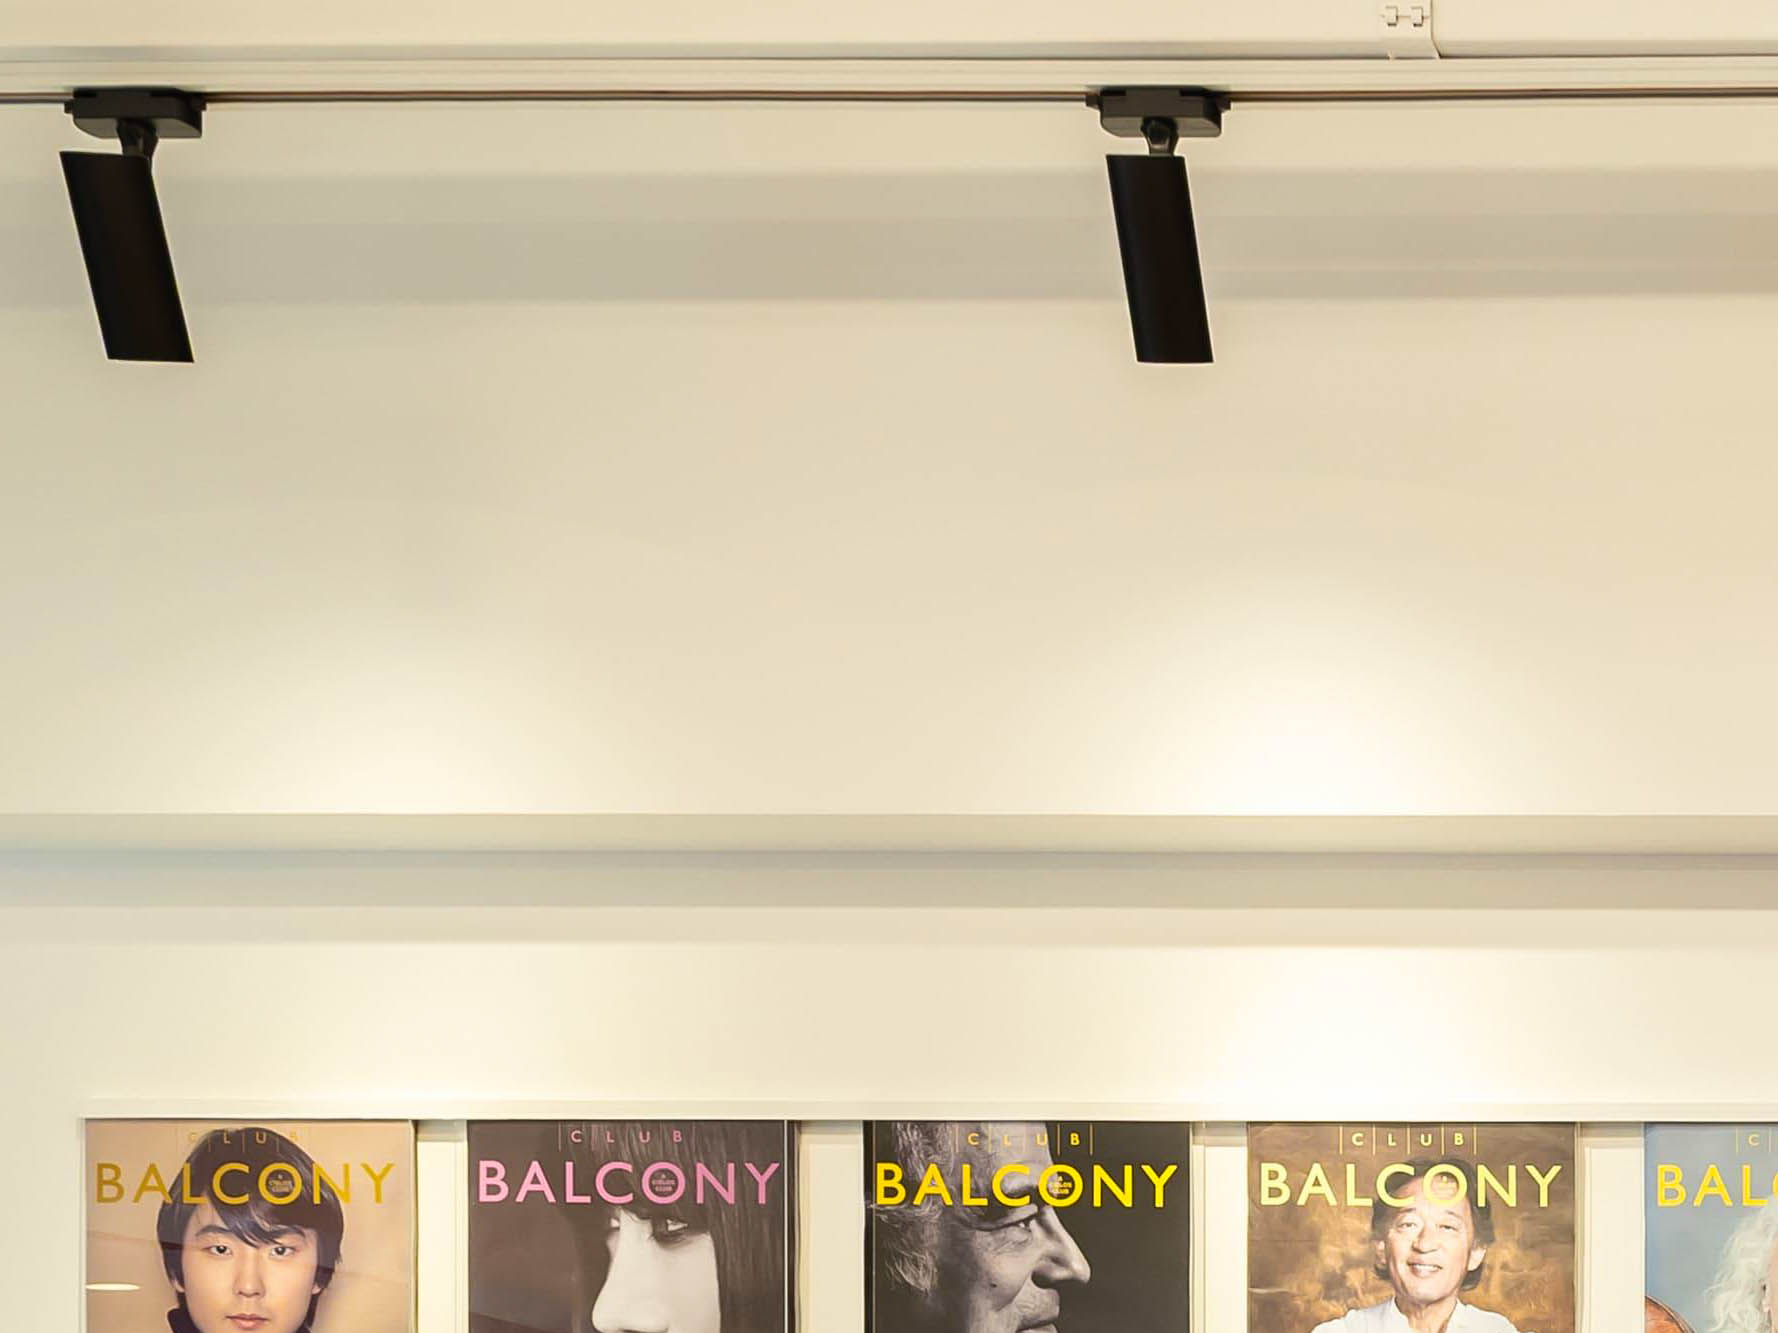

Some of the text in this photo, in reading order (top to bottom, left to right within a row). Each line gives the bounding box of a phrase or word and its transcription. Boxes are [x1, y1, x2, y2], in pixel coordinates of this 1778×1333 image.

[571, 1130, 683, 1143] CLUB
[968, 1133, 1080, 1146] CLUB
[1352, 1133, 1465, 1146] CLUB
[96, 1163, 395, 1204] BALCONY
[479, 1160, 780, 1204] BALCONY
[876, 1163, 1177, 1208] BALCONY
[1260, 1163, 1562, 1208] BALCONY
